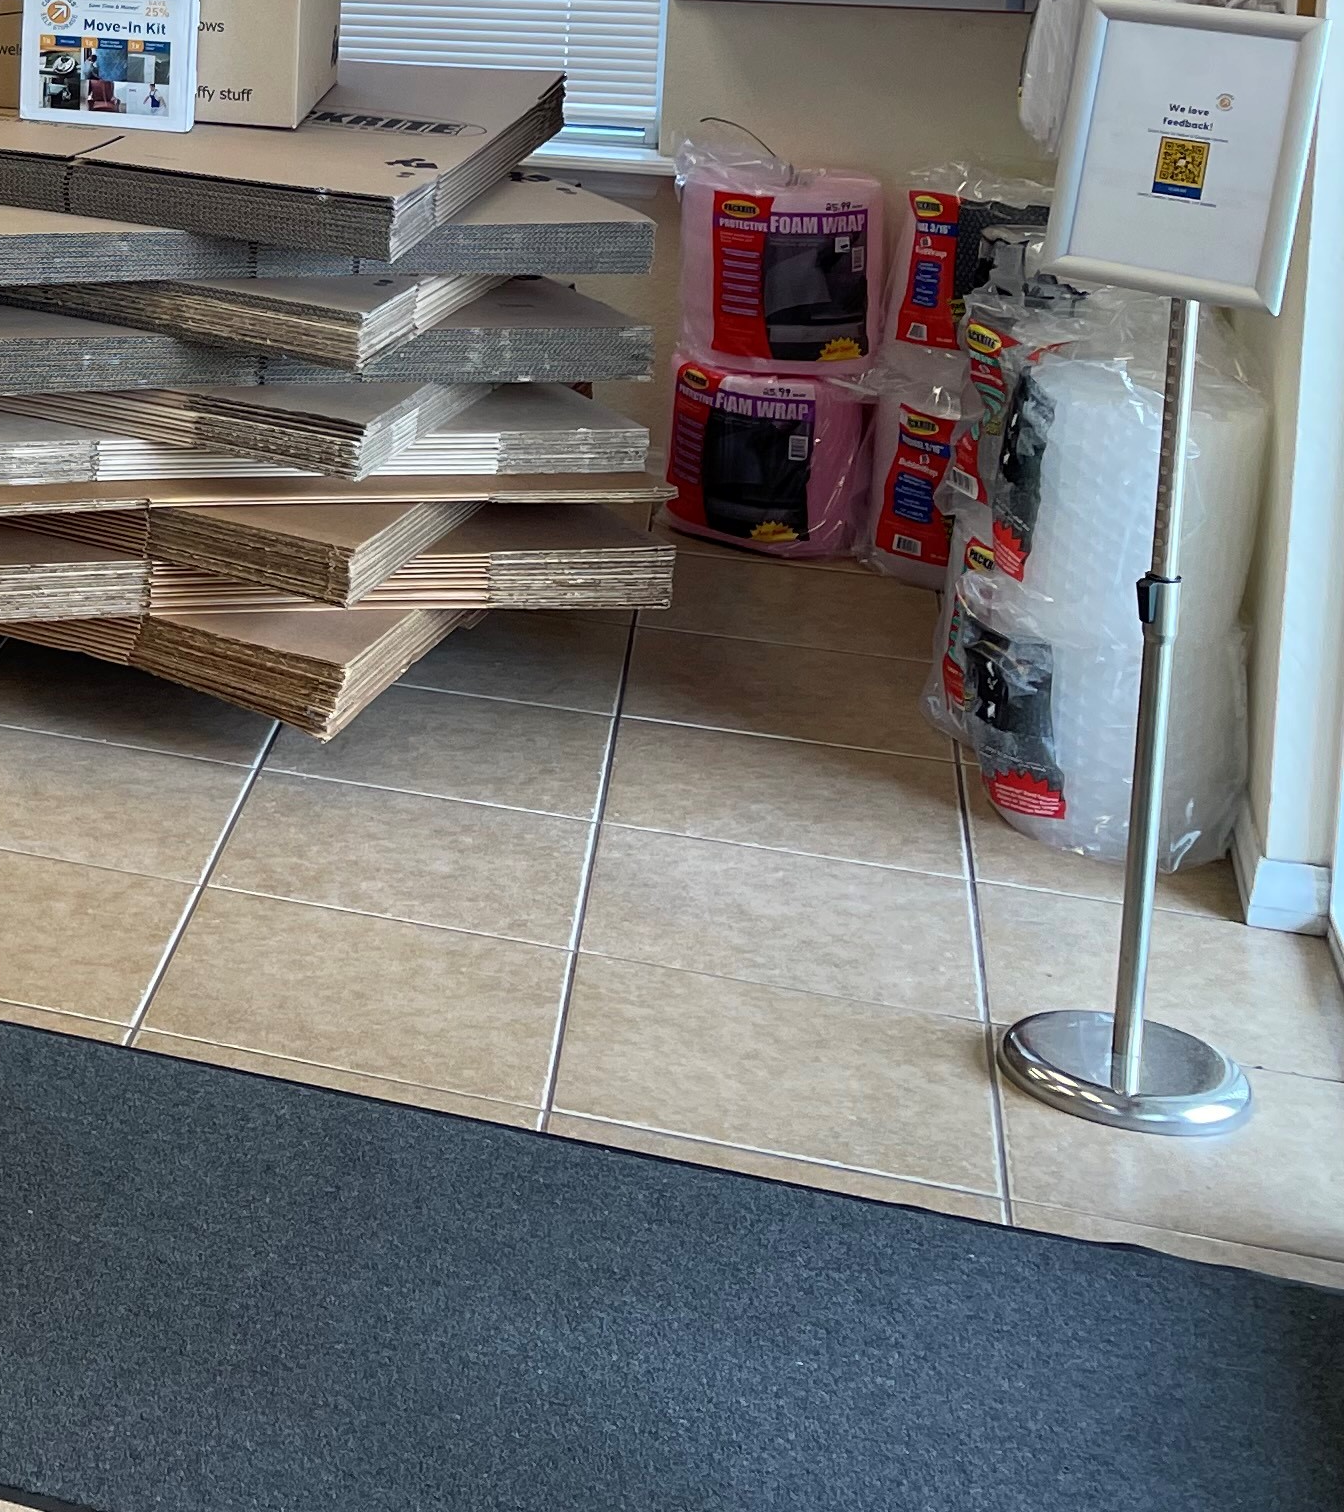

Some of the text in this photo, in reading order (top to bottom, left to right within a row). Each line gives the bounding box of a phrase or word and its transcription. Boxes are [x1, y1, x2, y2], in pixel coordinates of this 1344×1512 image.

[144, 6, 170, 18] 25%
[83, 18, 167, 36] Move-In Kit
[219, 88, 254, 102] stuff
[1169, 103, 1210, 117] We love
[1162, 116, 1214, 132] feedback!
[719, 214, 866, 235] PROTECTIVE FOAM WRAP
[757, 400, 809, 420] WRAP
